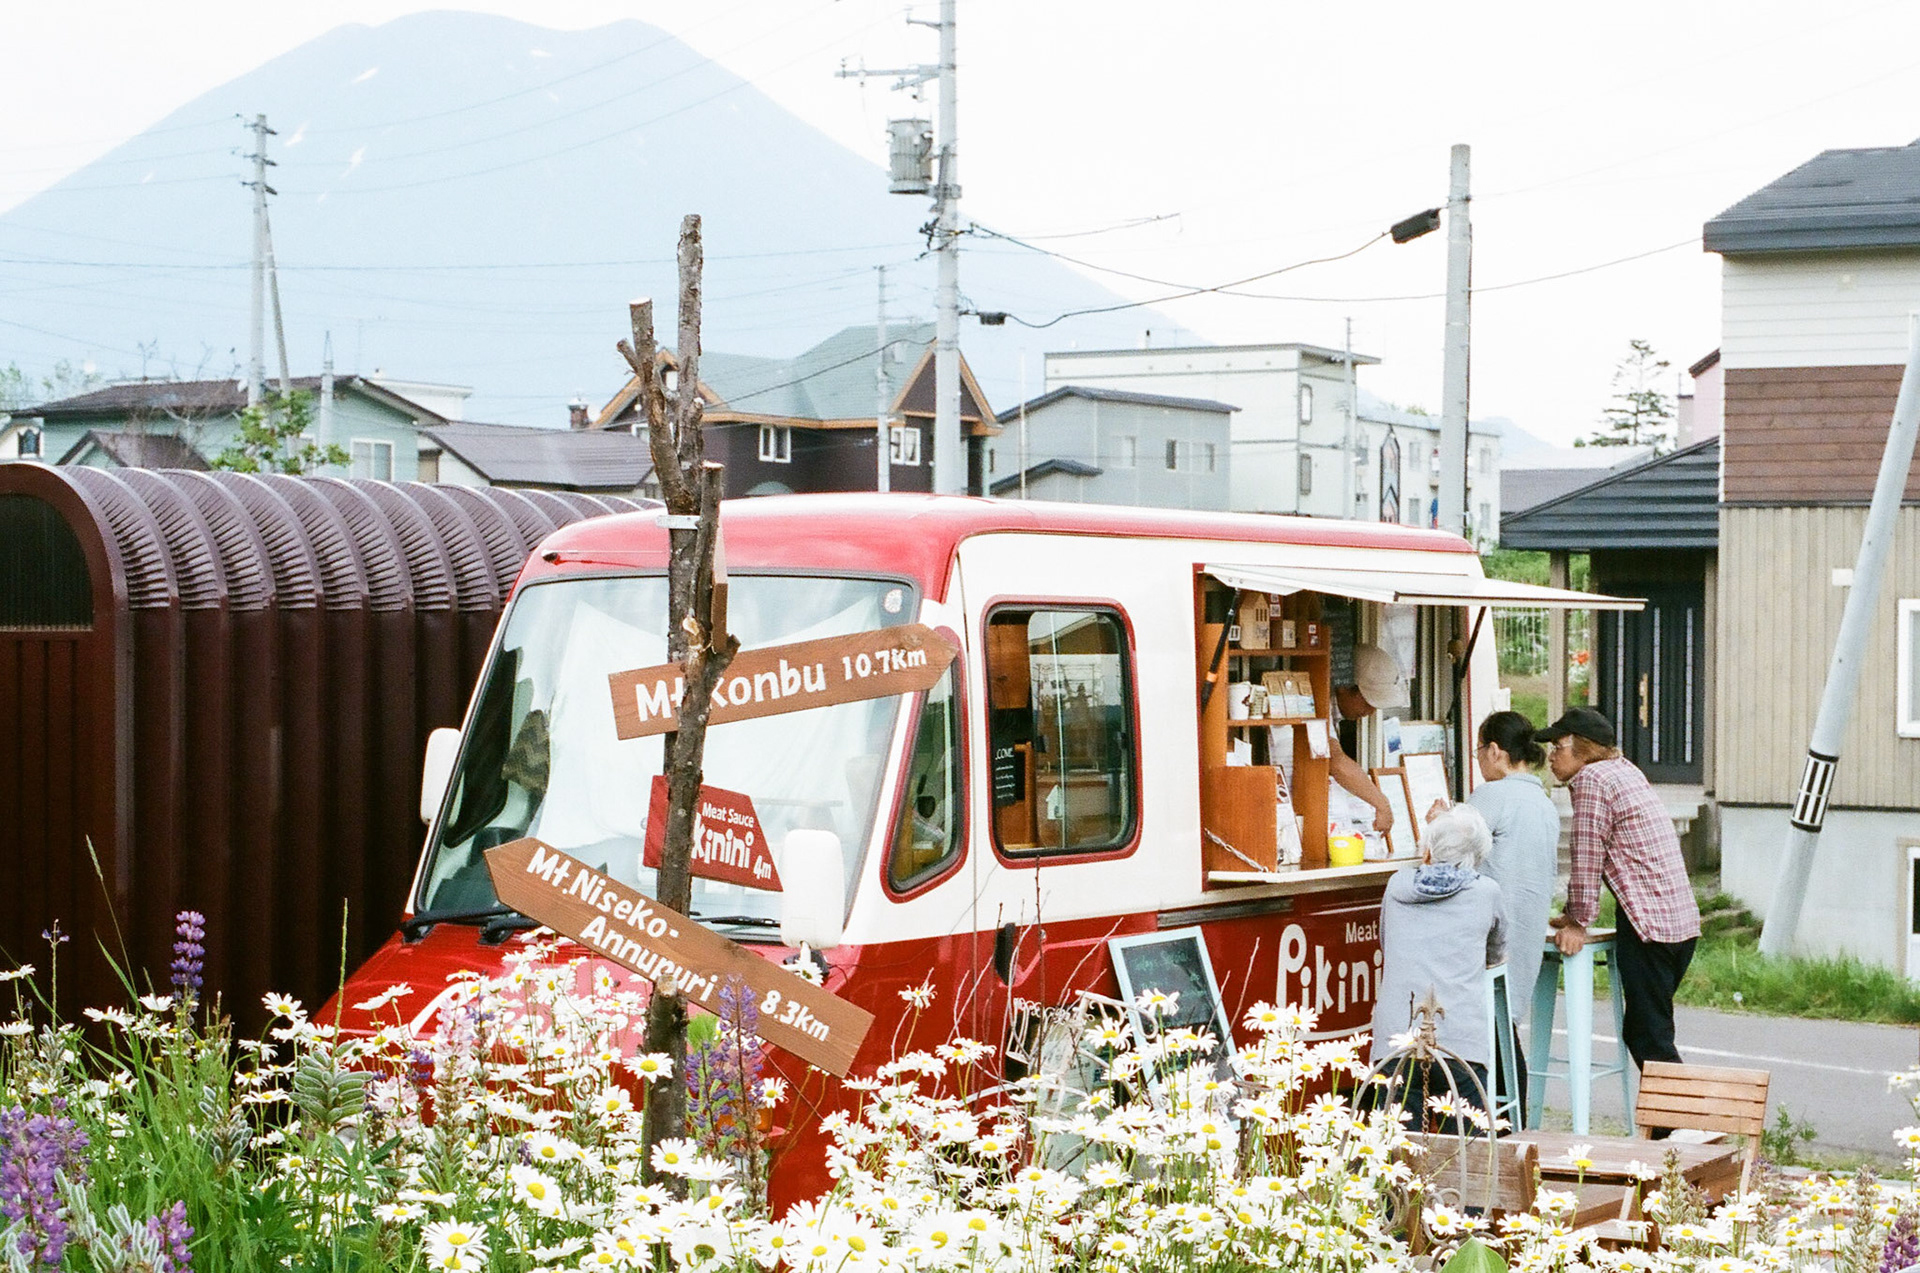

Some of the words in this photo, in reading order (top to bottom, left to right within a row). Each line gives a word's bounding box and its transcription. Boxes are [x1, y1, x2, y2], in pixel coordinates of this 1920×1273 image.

[691, 812, 755, 869] kinini
[702, 802, 727, 821] Meat
[727, 808, 754, 828] Sauce
[753, 855, 772, 879] 4m
[1345, 920, 1378, 944] Meat
[579, 915, 718, 1002] Annupuri
[1276, 923, 1382, 1014] Pikini
[760, 990, 830, 1042] 8.3km
